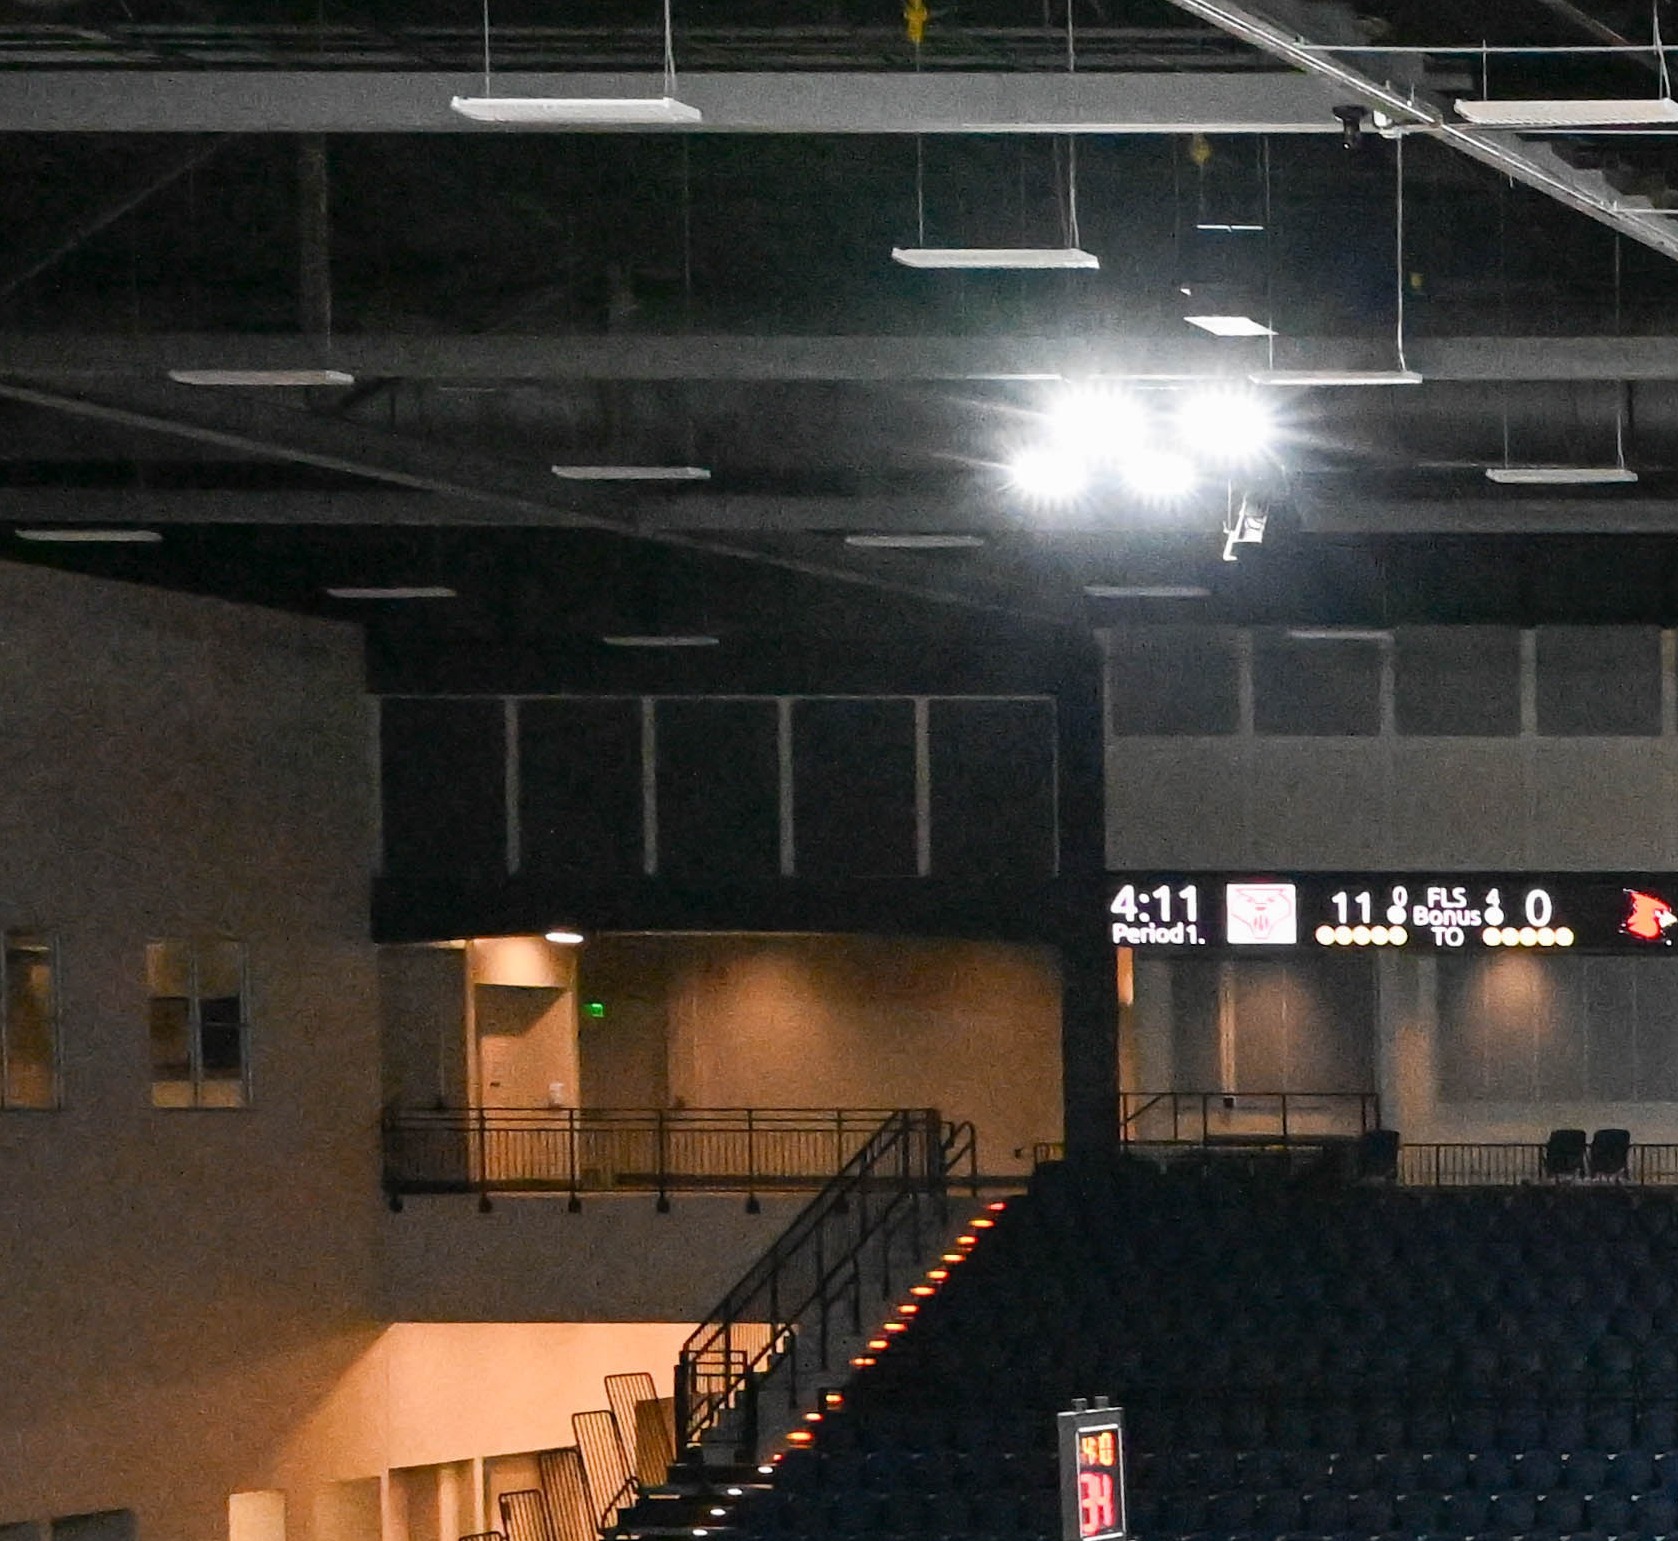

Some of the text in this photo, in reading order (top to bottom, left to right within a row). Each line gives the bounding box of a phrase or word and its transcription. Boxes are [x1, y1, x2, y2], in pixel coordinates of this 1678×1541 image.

[1109, 884, 1200, 922] 4:11
[1331, 890, 1372, 924] 11
[1427, 886, 1468, 908] FLS
[1524, 888, 1553, 925] 0
[1413, 905, 1483, 927] Bonus
[1112, 922, 1185, 945] Period
[1432, 925, 1466, 947] TO
[1080, 1471, 1114, 1537] 34
